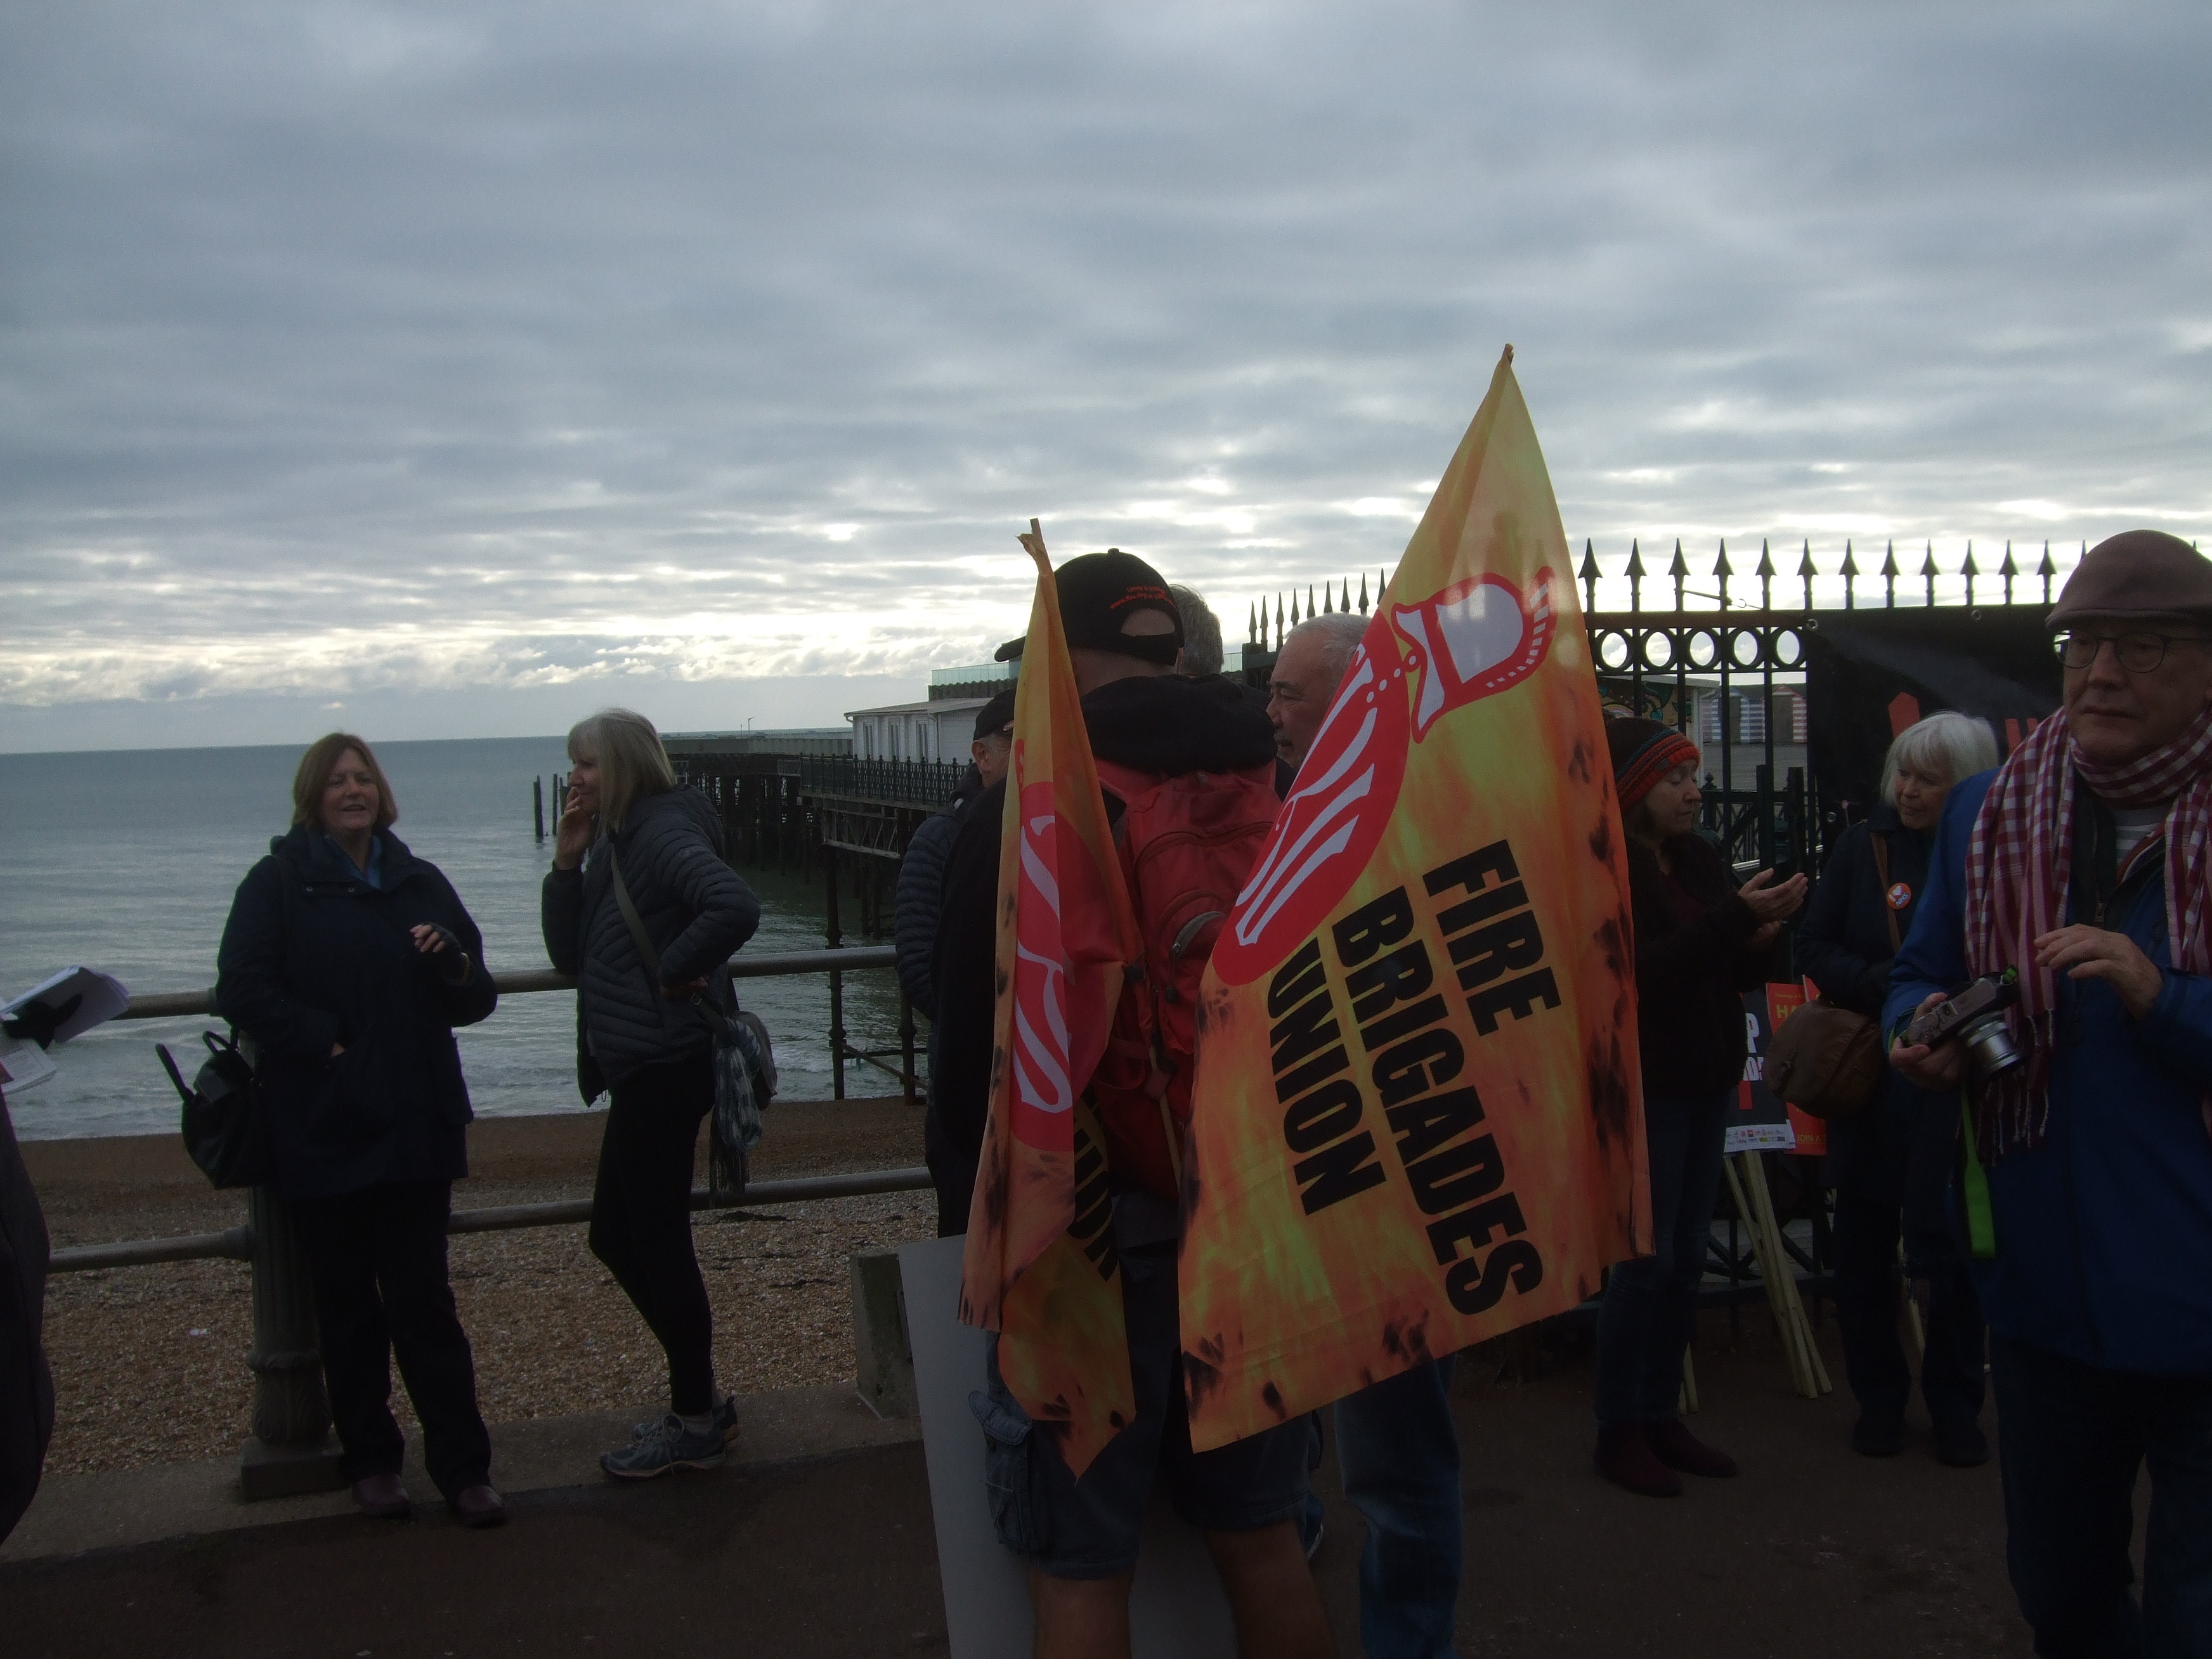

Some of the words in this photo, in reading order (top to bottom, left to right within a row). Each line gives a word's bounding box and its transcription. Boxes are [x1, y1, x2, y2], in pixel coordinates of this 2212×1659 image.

[1268, 937, 1387, 1215] UNION
[1423, 839, 1561, 1036] FIRE
[1332, 885, 1543, 1315] BRIGADES
